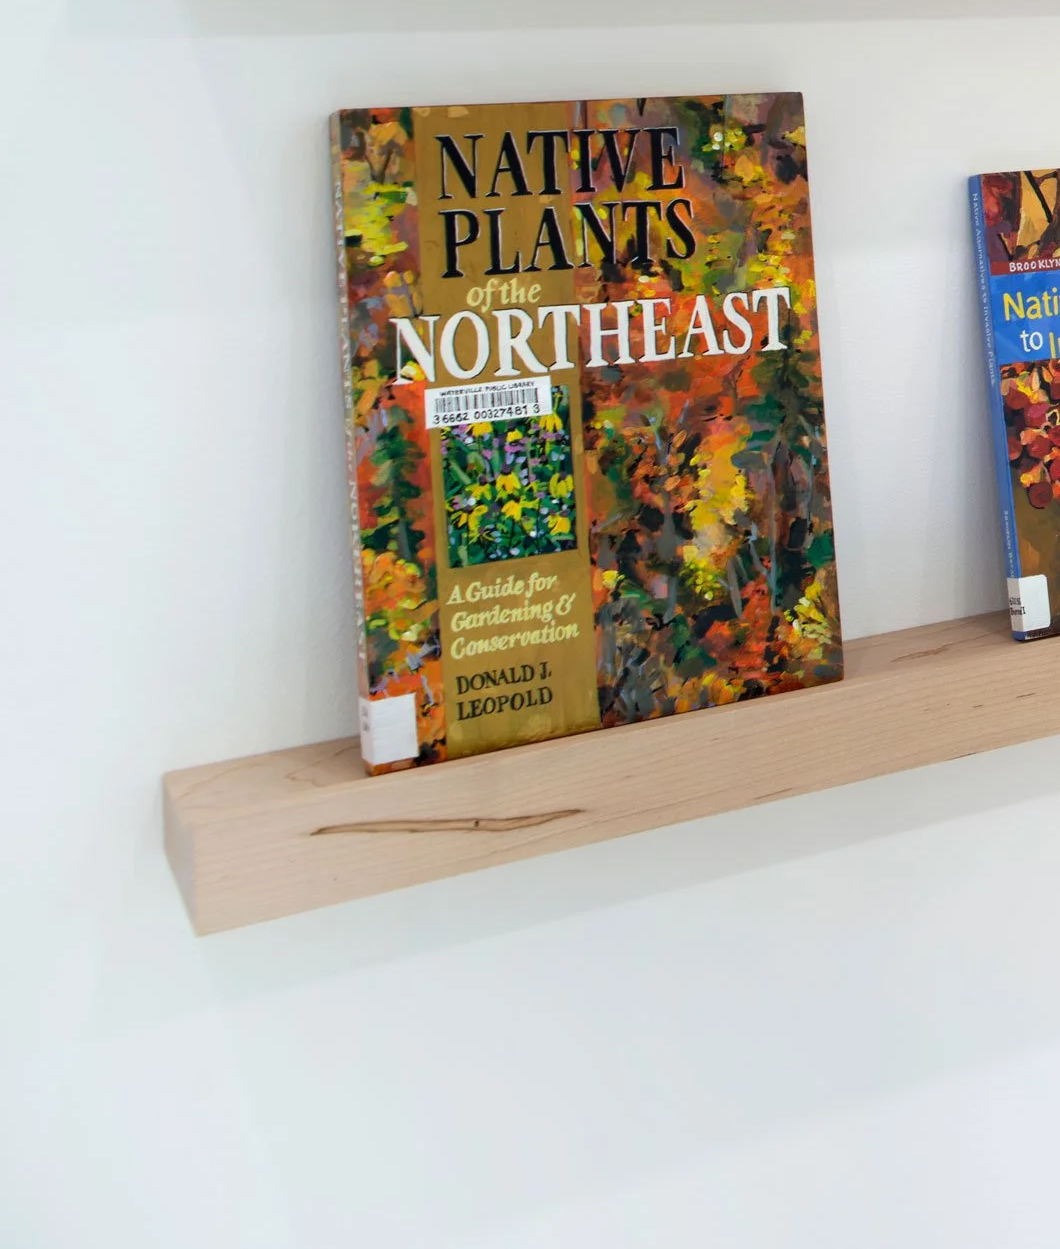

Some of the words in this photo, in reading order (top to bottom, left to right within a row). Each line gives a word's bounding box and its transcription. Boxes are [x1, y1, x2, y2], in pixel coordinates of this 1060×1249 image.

[436, 126, 685, 201] NATIVE
[440, 198, 697, 280] PLANTS
[972, 193, 980, 226] Native
[983, 306, 992, 349] Invasive
[1009, 258, 1060, 272] BROOKLYN
[466, 281, 499, 314] of
[499, 278, 541, 306] the
[389, 287, 791, 386] NORTHEAST
[1020, 329, 1043, 353] to
[507, 381, 535, 390] LIBRARY
[433, 415, 440, 424] 3
[474, 405, 528, 420] 00327481
[533, 404, 540, 414] 3
[446, 584, 465, 606] A
[465, 575, 525, 604] Guide
[524, 571, 557, 599] for
[450, 600, 554, 633] Gardening
[556, 592, 576, 617] &
[450, 619, 580, 660] Conservation
[455, 663, 535, 695] DONALD
[539, 661, 553, 681] J.
[456, 686, 553, 721] LEOPOLD
